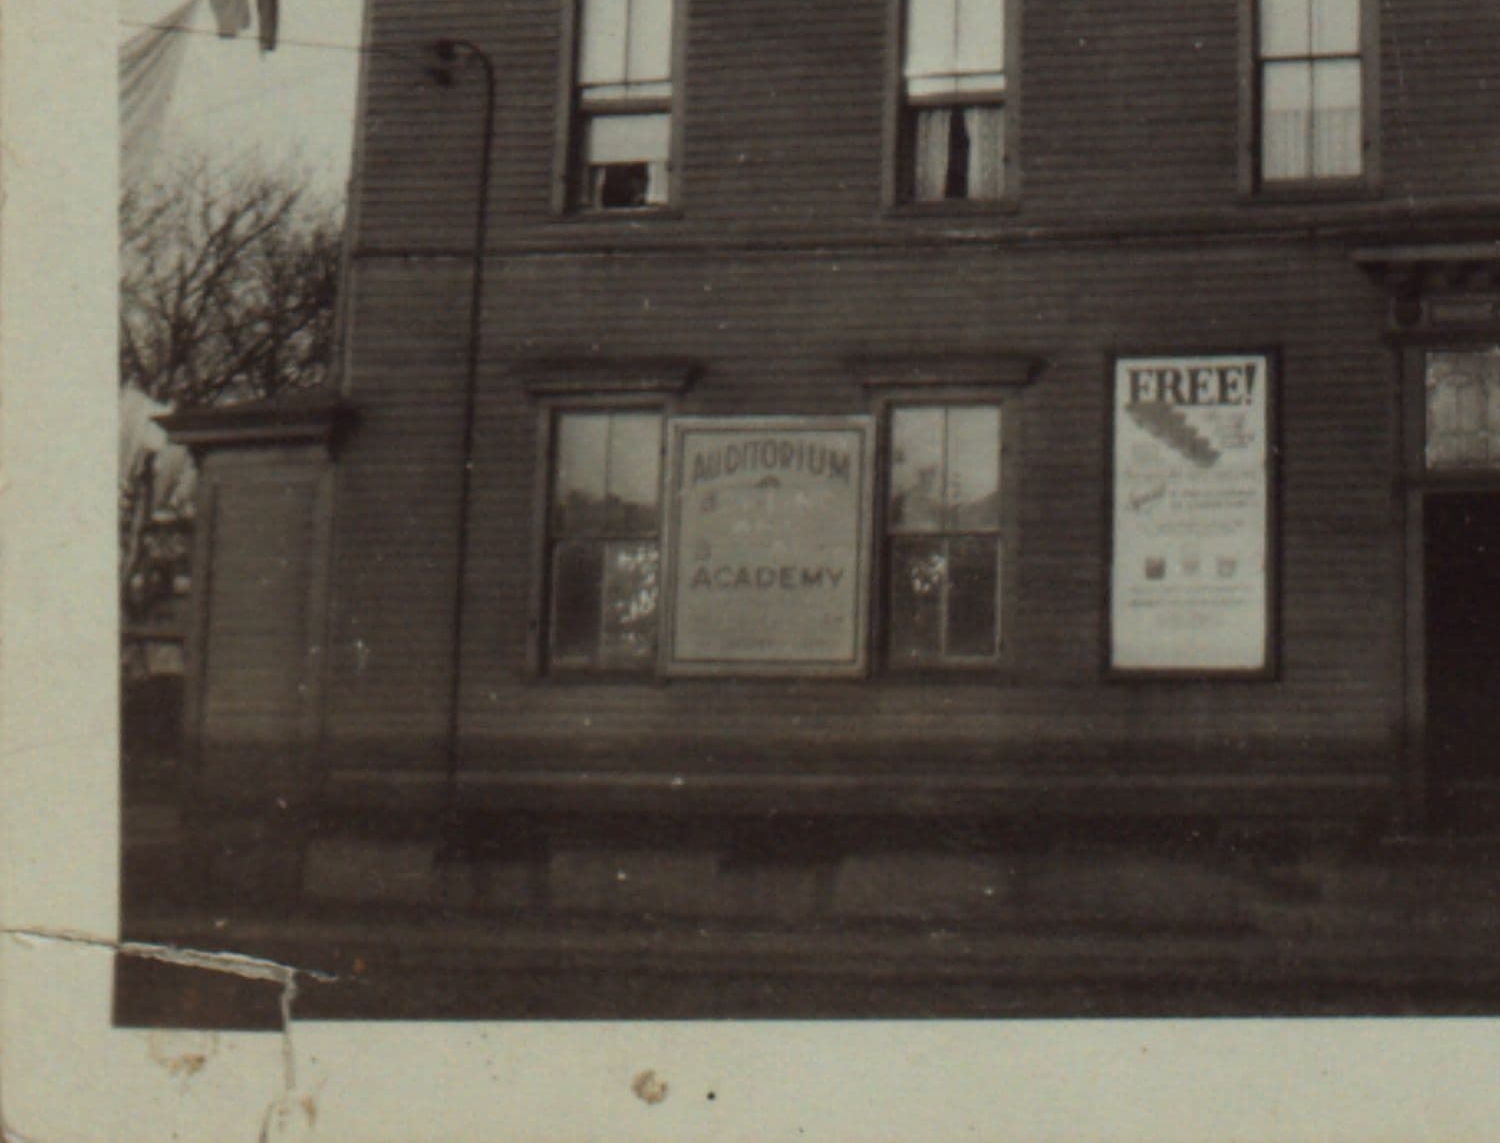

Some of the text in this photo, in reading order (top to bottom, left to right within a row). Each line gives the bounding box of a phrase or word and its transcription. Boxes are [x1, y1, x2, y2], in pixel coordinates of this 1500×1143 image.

[1127, 362, 1257, 406] FREE!
[693, 438, 851, 485] AUDITORIUM
[690, 564, 844, 590] ACADEMY
